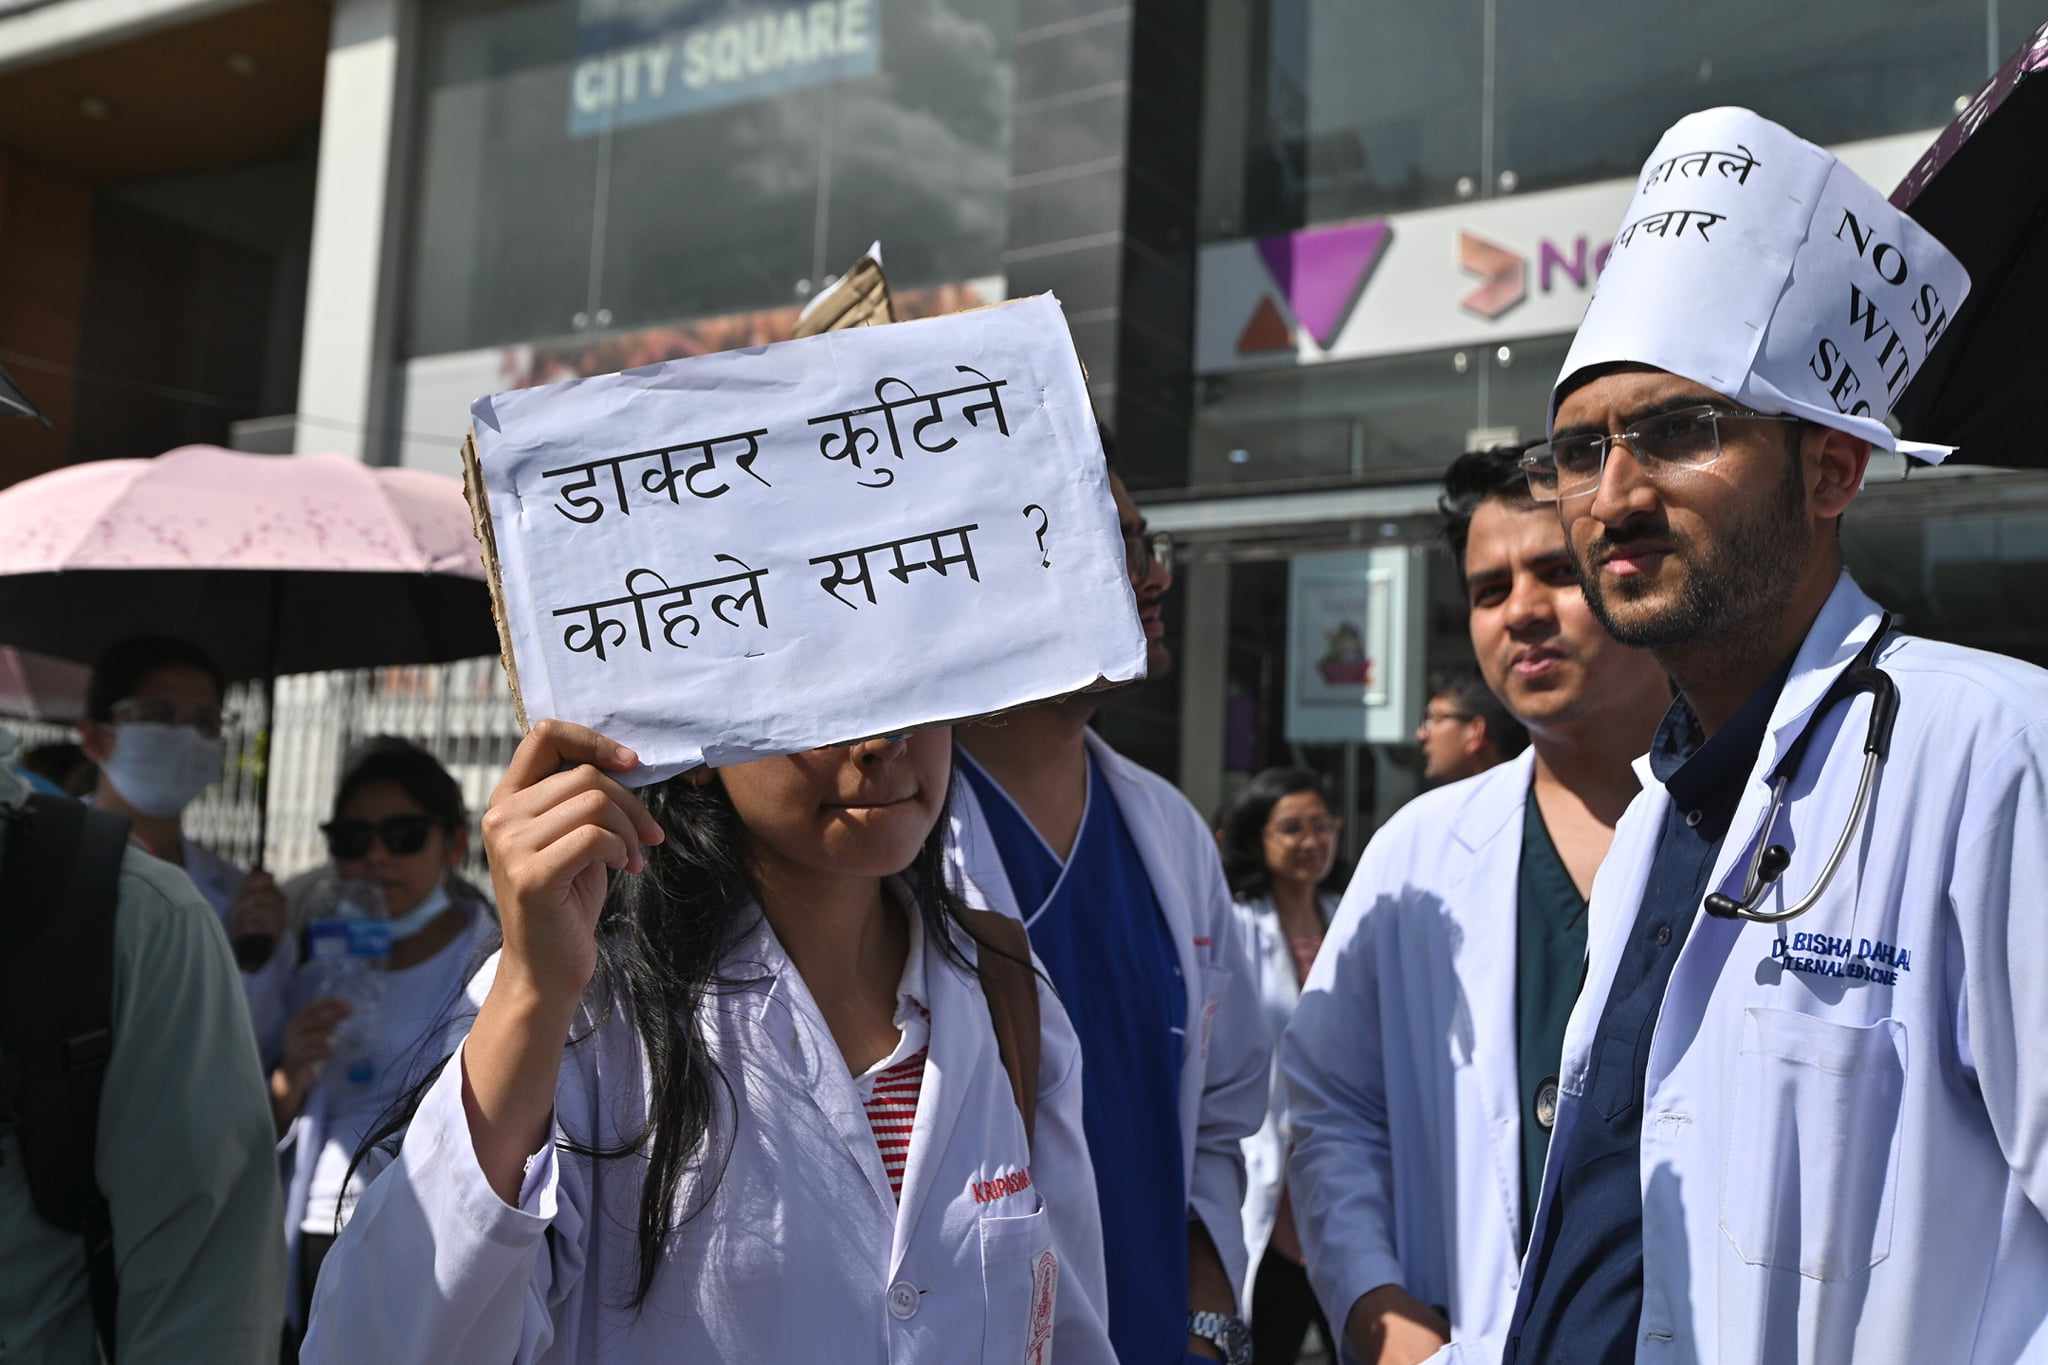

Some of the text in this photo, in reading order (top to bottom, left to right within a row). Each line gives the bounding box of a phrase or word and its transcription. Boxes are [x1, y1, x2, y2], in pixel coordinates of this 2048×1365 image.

[574, 0, 868, 112] CITY SQUARE
[1832, 207, 1908, 287] NO
[1850, 281, 1912, 412] WIT
[542, 365, 1010, 525] डाक्टर कुटिने
[552, 503, 1053, 662] कहिले सम्म ?
[1792, 932, 1852, 959] BISHA
